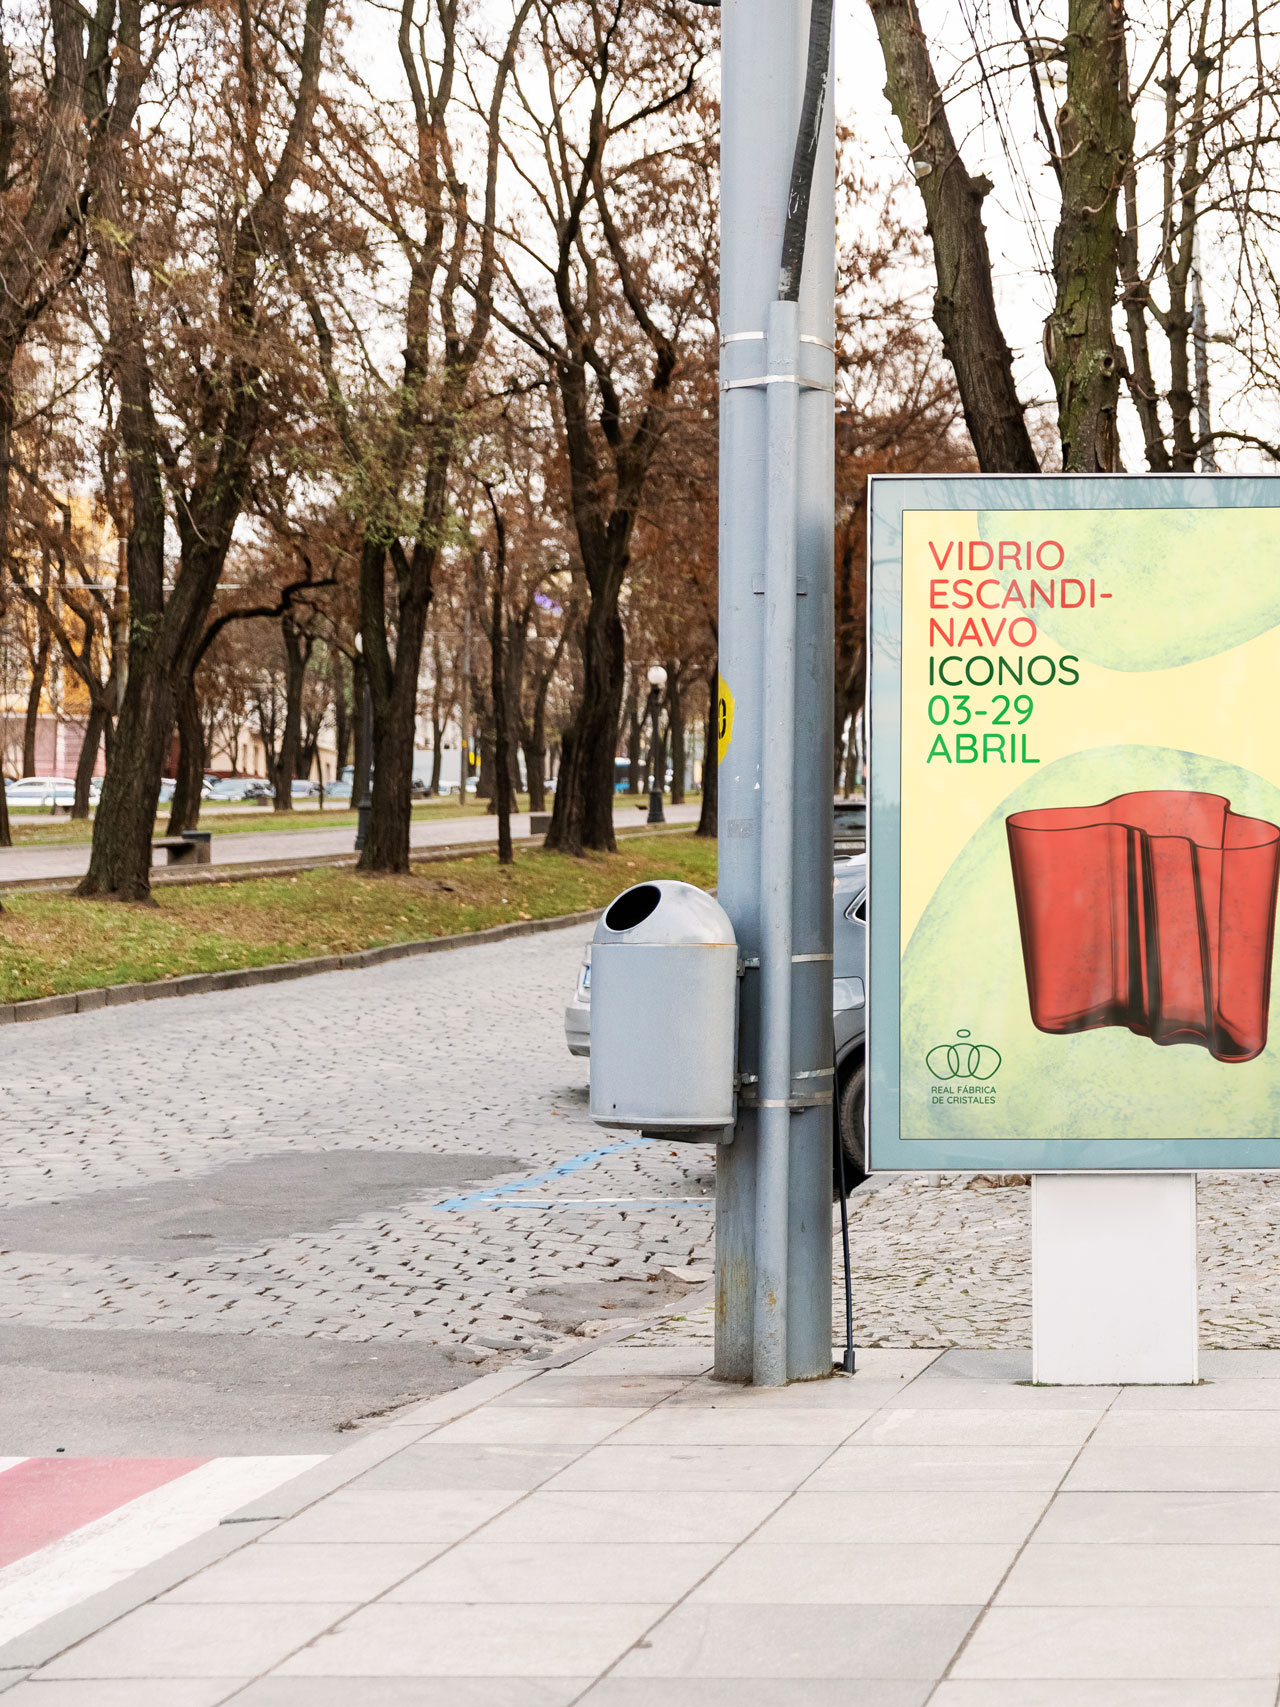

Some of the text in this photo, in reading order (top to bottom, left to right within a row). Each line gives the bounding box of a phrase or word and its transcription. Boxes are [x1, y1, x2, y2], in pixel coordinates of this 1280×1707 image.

[928, 540, 1065, 571] VIDRIO
[929, 578, 1113, 609] ESCANDI-
[929, 616, 1038, 648] NAVO
[929, 655, 1080, 686] ICONOS
[927, 694, 1034, 726] 03-29
[926, 733, 1041, 764] ABRIL
[931, 1085, 997, 1094] REAL FÁBRICA
[931, 1096, 996, 1105] DE CRISTALES
